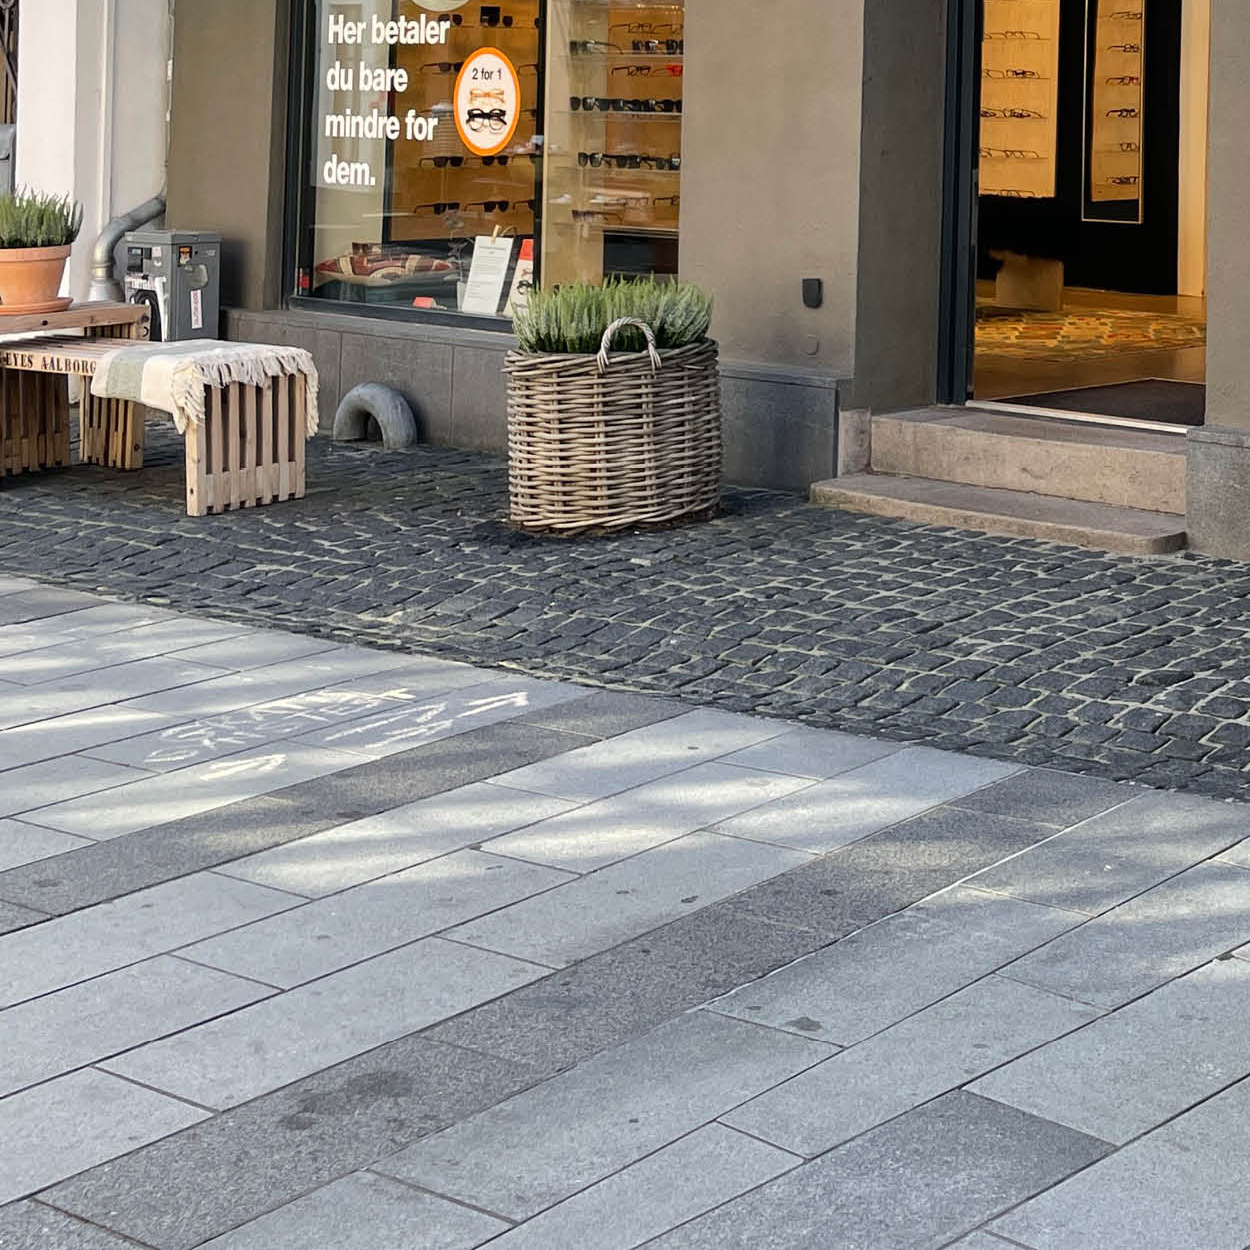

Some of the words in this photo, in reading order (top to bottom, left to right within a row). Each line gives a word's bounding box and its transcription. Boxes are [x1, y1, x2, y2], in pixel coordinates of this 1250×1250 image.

[327, 13, 367, 45] Her
[371, 14, 451, 45] betaler
[326, 61, 353, 91] du
[358, 64, 409, 93] bare
[471, 68, 479, 81] 2
[480, 68, 494, 81] for
[496, 68, 503, 81] 1
[324, 110, 400, 141] mindre
[404, 109, 439, 141] for
[323, 154, 376, 187] dem.
[5, 352, 34, 369] EYES
